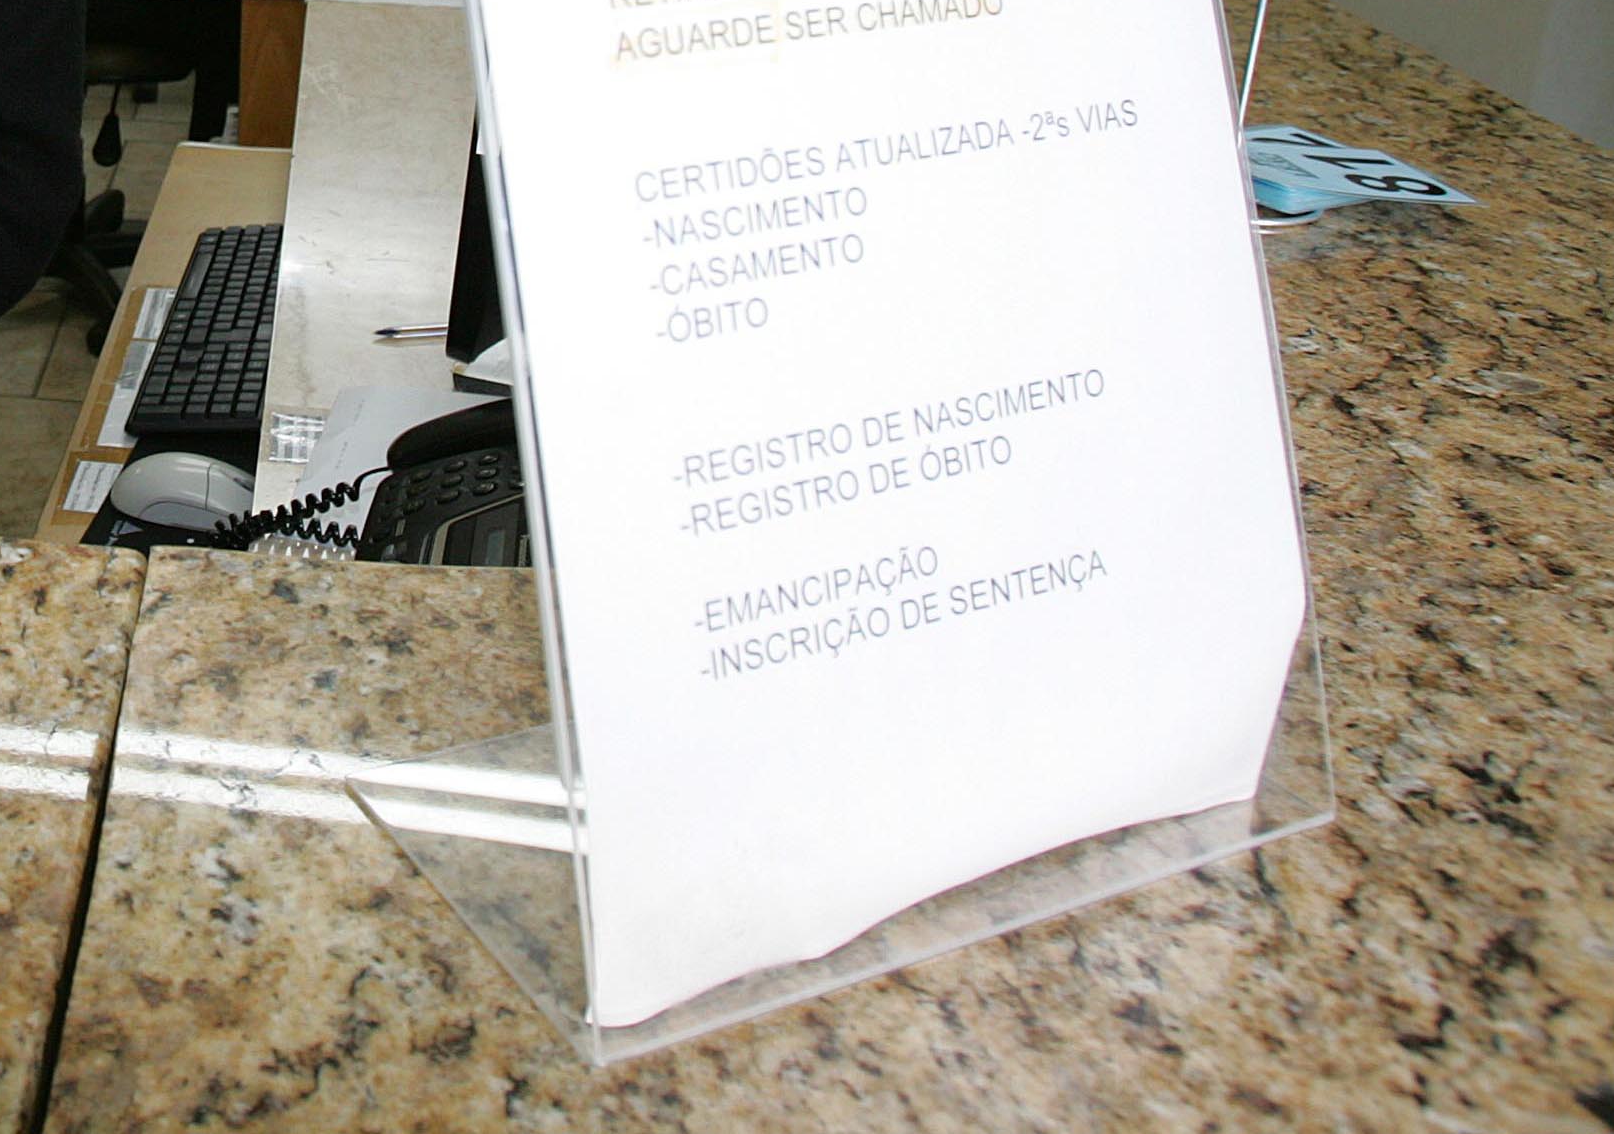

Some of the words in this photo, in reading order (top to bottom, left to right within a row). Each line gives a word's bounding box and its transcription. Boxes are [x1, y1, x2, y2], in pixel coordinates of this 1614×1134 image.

[615, 15, 777, 62] AGUARDE
[785, 7, 849, 40] SER
[634, 147, 826, 202] CERTIDÕES
[835, 119, 1015, 172] ATUALIZADA
[1076, 99, 1139, 133] VIAS
[642, 187, 869, 248] -NASCIMENTO
[649, 233, 865, 296] -CASAMENTO
[656, 297, 769, 343] -ÓBITO
[673, 423, 853, 488] -REGISTRO
[862, 411, 904, 448] DE
[913, 369, 1105, 436] NASCIMENTO
[681, 470, 860, 537] -REGISTRO
[869, 458, 911, 495] DE
[919, 435, 1012, 482] ÓBITO
[694, 546, 939, 633] -EMANCIPAÇÃO
[700, 607, 891, 681] -INSCRIÇÃO
[899, 592, 942, 630] DE
[949, 550, 1108, 616] SENTENÇA
